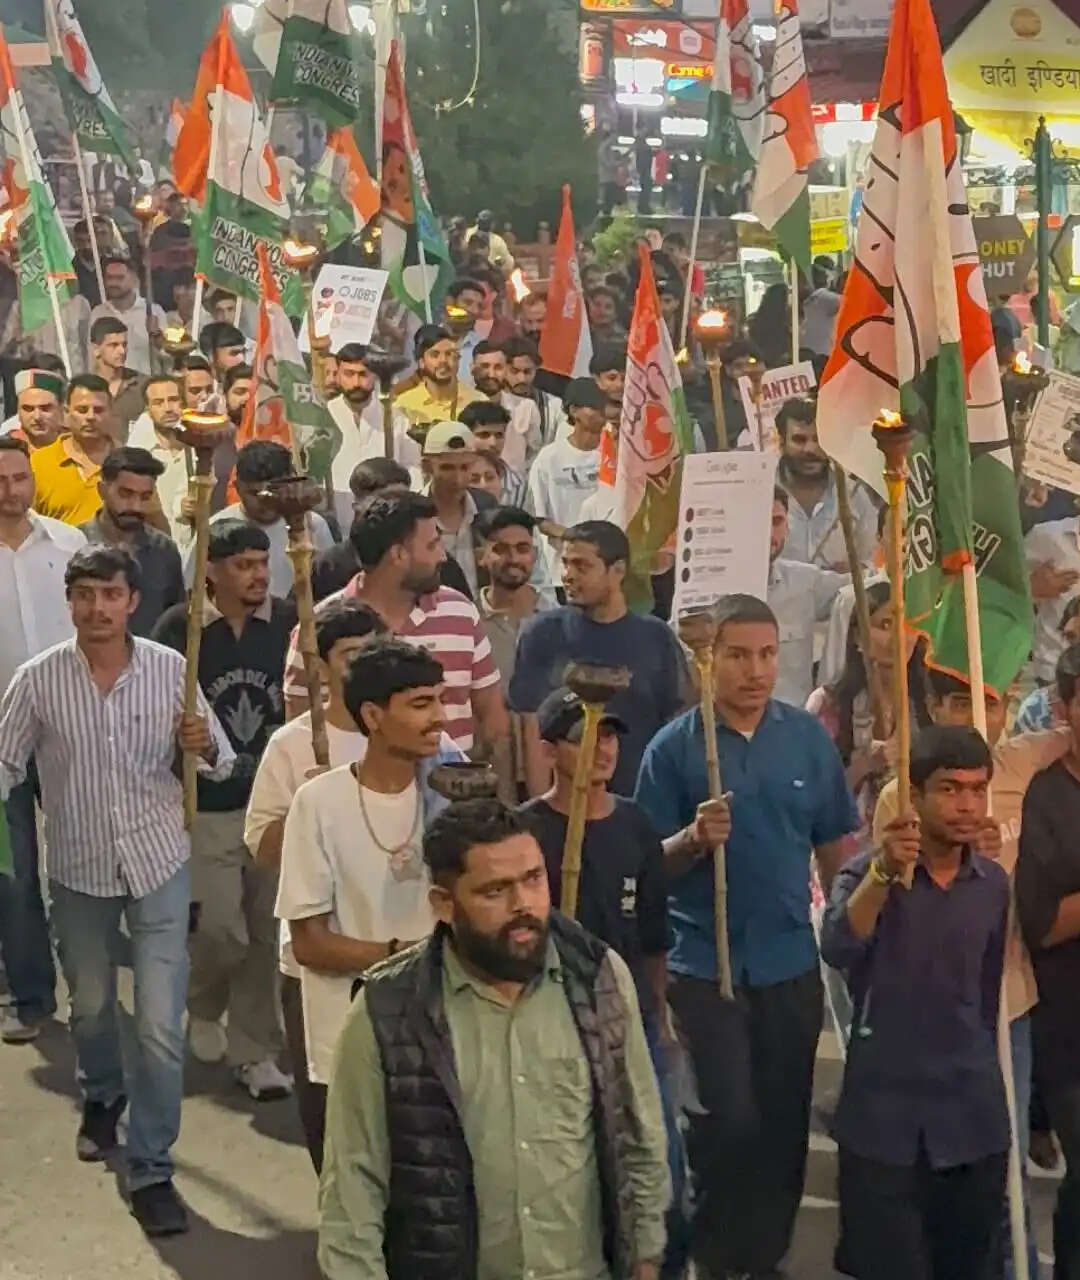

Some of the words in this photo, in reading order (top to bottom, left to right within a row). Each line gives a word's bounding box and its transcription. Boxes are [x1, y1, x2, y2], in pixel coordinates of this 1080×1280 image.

[979, 57, 1017, 88] खादी
[980, 239, 1026, 257] ONEY
[981, 261, 1017, 279] HUT
[761, 374, 811, 401] ANTED
